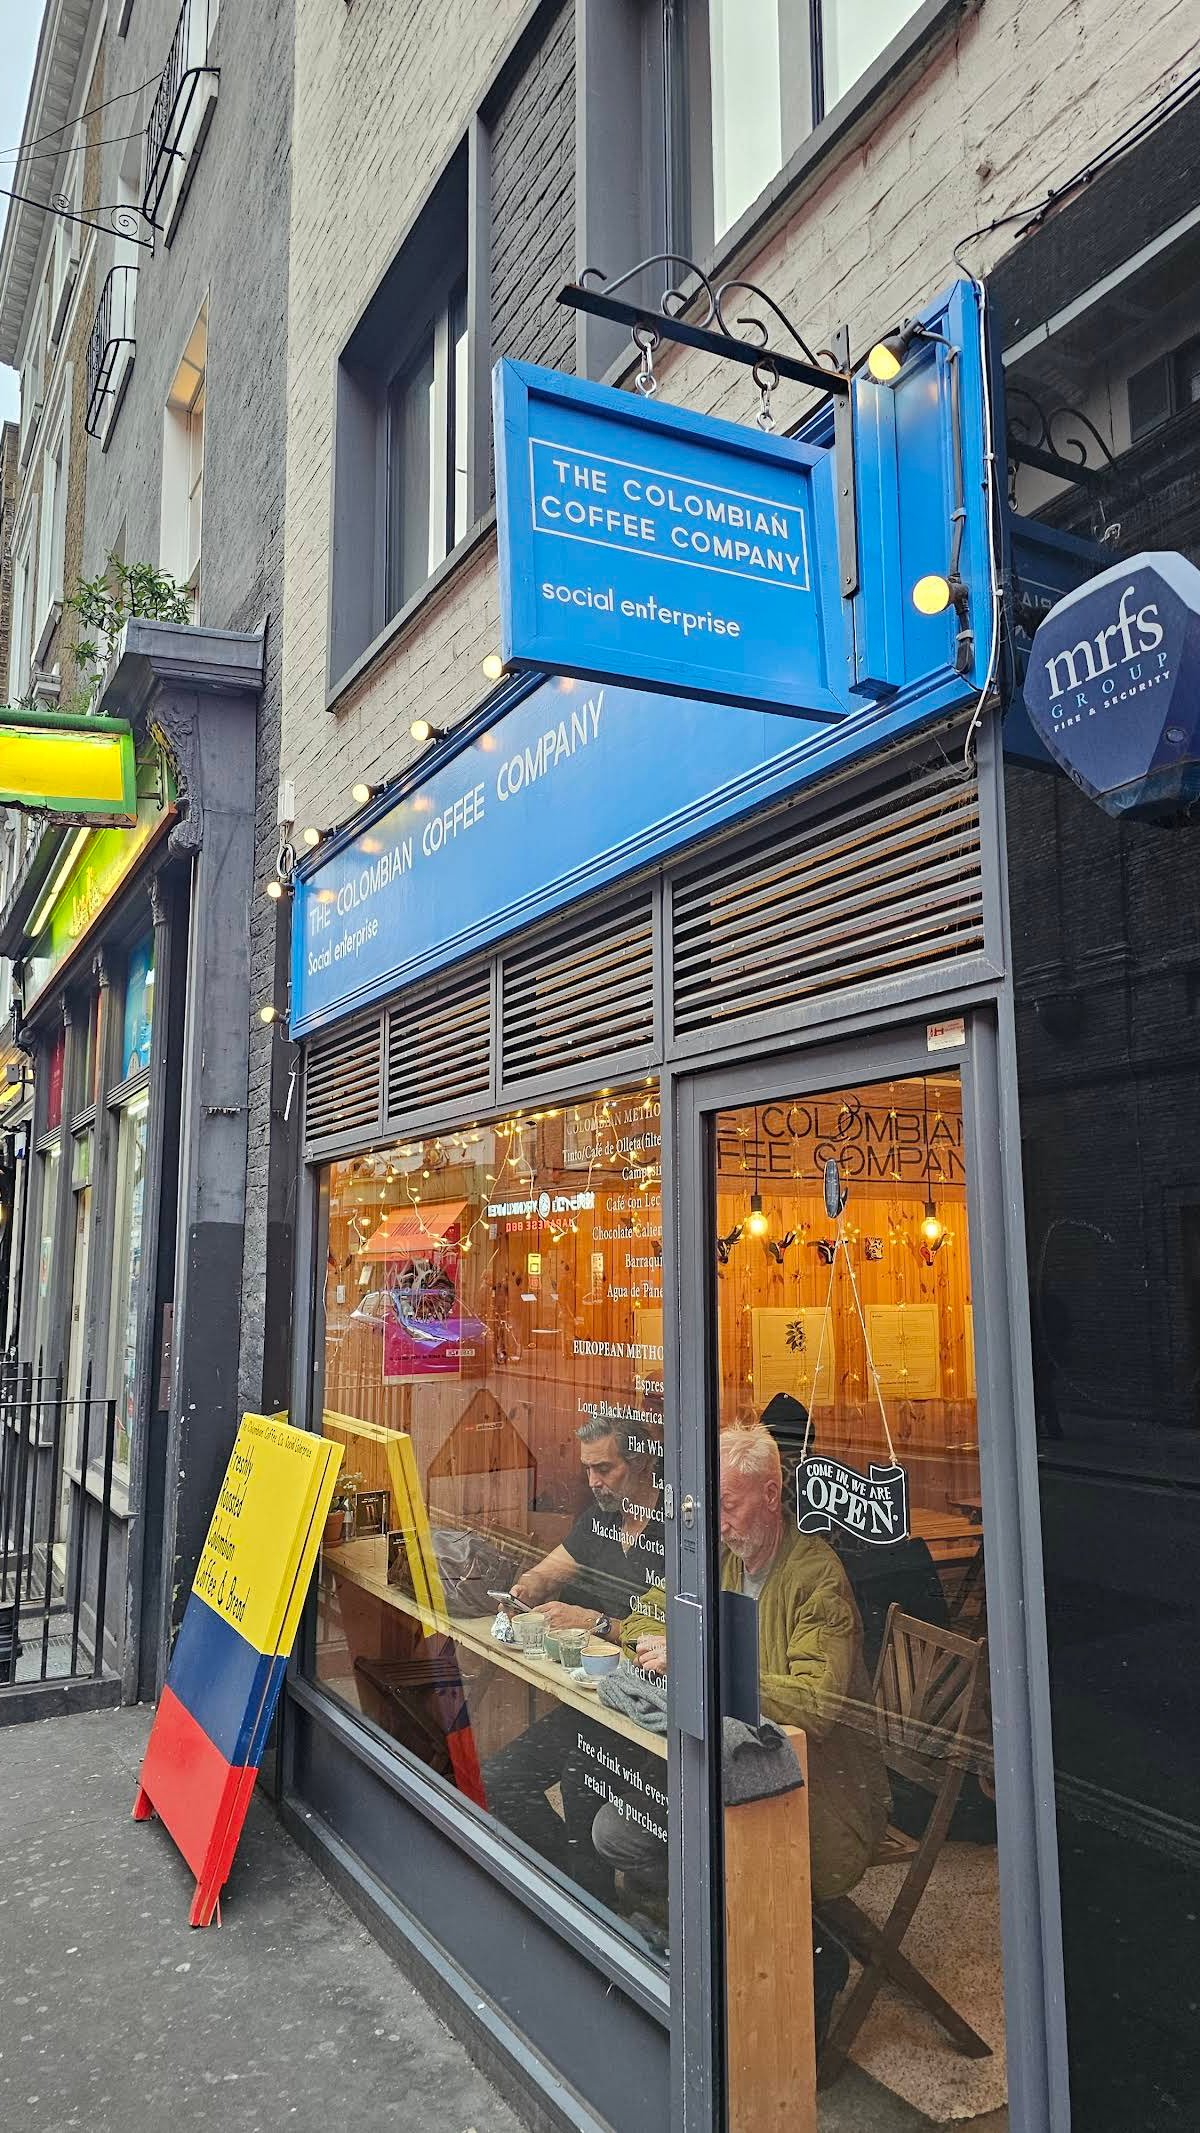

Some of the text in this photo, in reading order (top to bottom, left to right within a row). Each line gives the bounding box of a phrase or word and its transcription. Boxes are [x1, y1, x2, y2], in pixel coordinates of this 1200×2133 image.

[552, 460, 789, 540] THE COLOMBIAN
[541, 495, 800, 576] COFFEE COMPANY
[542, 581, 741, 637] social enterprise
[1044, 585, 1164, 700] mrfs
[1051, 652, 1167, 719] GROUP
[1054, 670, 1171, 733] FIRE & SECURITY
[309, 690, 605, 937] THE COLOMBIAN COFFEE COMPANY
[308, 917, 379, 976] Social enterprise
[604, 1141, 614, 1155] de
[606, 1195, 625, 1211] Café
[627, 1197, 642, 1209] con
[592, 1224, 633, 1240] Chocolate
[607, 1283, 628, 1302] Agua
[630, 1282, 640, 1298] de
[573, 1340, 624, 1357] EUROPEAN
[577, 1398, 598, 1419] Long
[628, 1435, 663, 1457] Flat Wh
[652, 1472, 664, 1490] La
[806, 1464, 834, 1478] COME
[852, 1478, 867, 1496] WE
[869, 1486, 892, 1500] ARE
[622, 1497, 664, 1522] Cappucci
[806, 1476, 894, 1534] OPEN
[592, 1518, 665, 1556] Macchiato/Corta
[225, 1576, 251, 1623] Bread
[629, 1595, 665, 1623] Chai La
[627, 1659, 646, 1681] Iced
[577, 1733, 595, 1758] Free
[596, 1746, 621, 1776] drink
[622, 1765, 643, 1791] with
[584, 1772, 668, 1843] retail bag purchase
